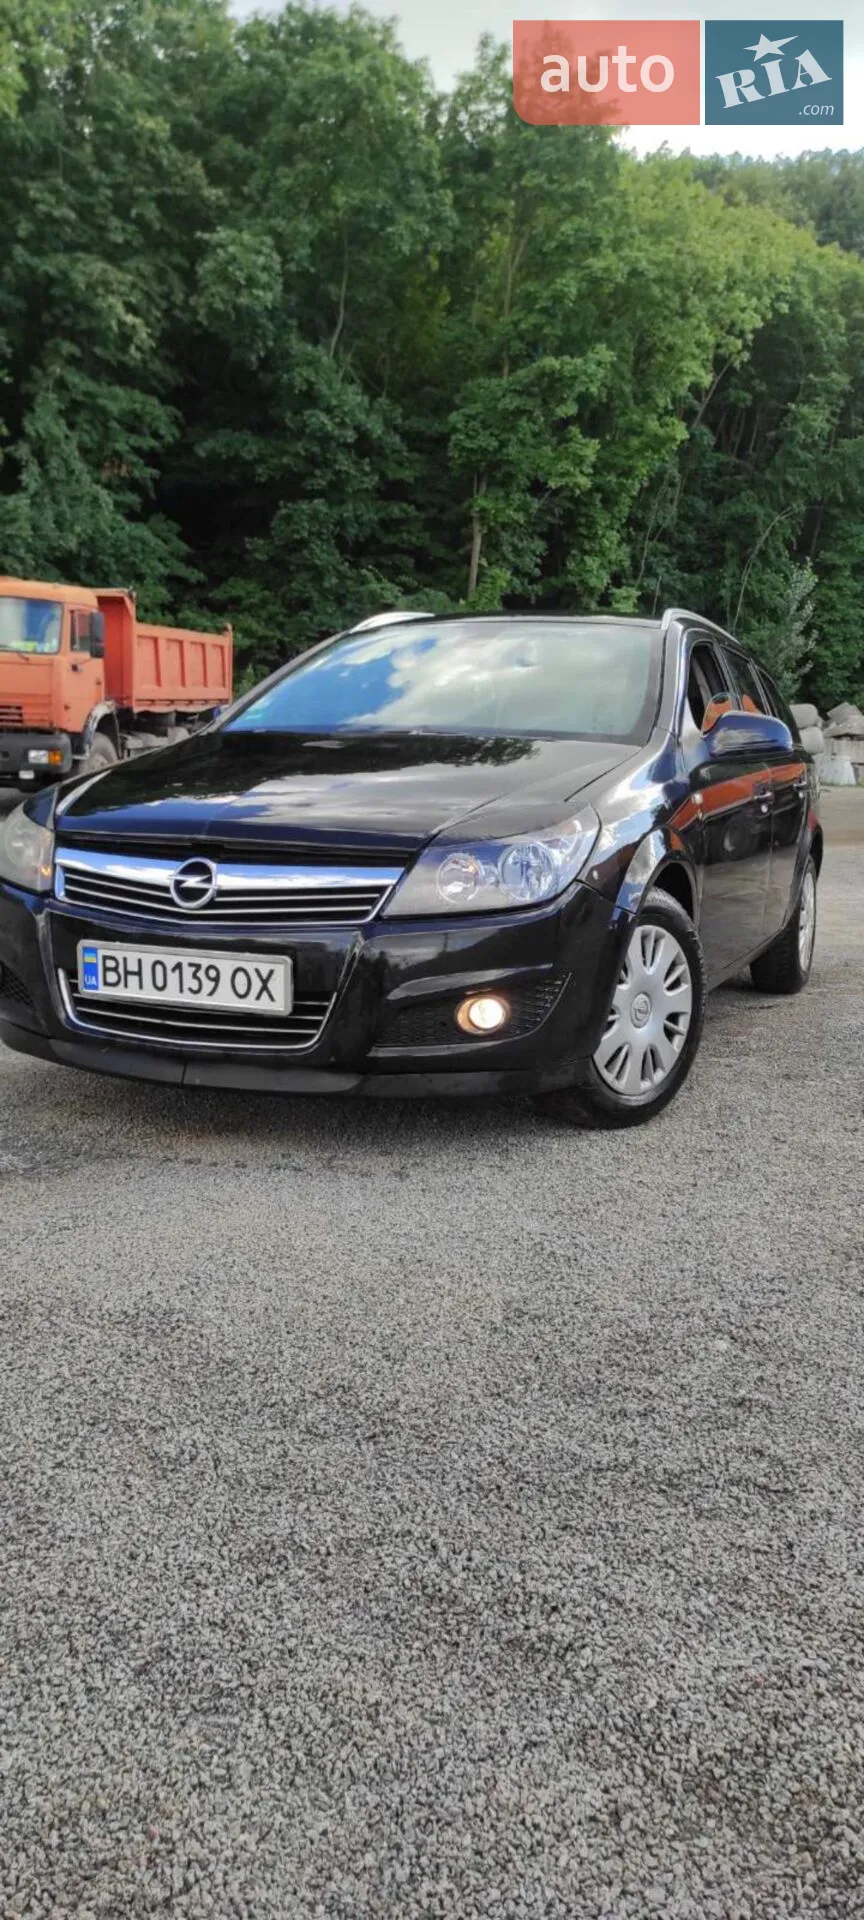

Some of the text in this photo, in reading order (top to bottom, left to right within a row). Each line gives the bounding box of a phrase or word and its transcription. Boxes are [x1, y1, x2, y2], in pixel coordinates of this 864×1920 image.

[84, 976, 97, 986] UA
[102, 954, 275, 1002] BH 0139 OX
